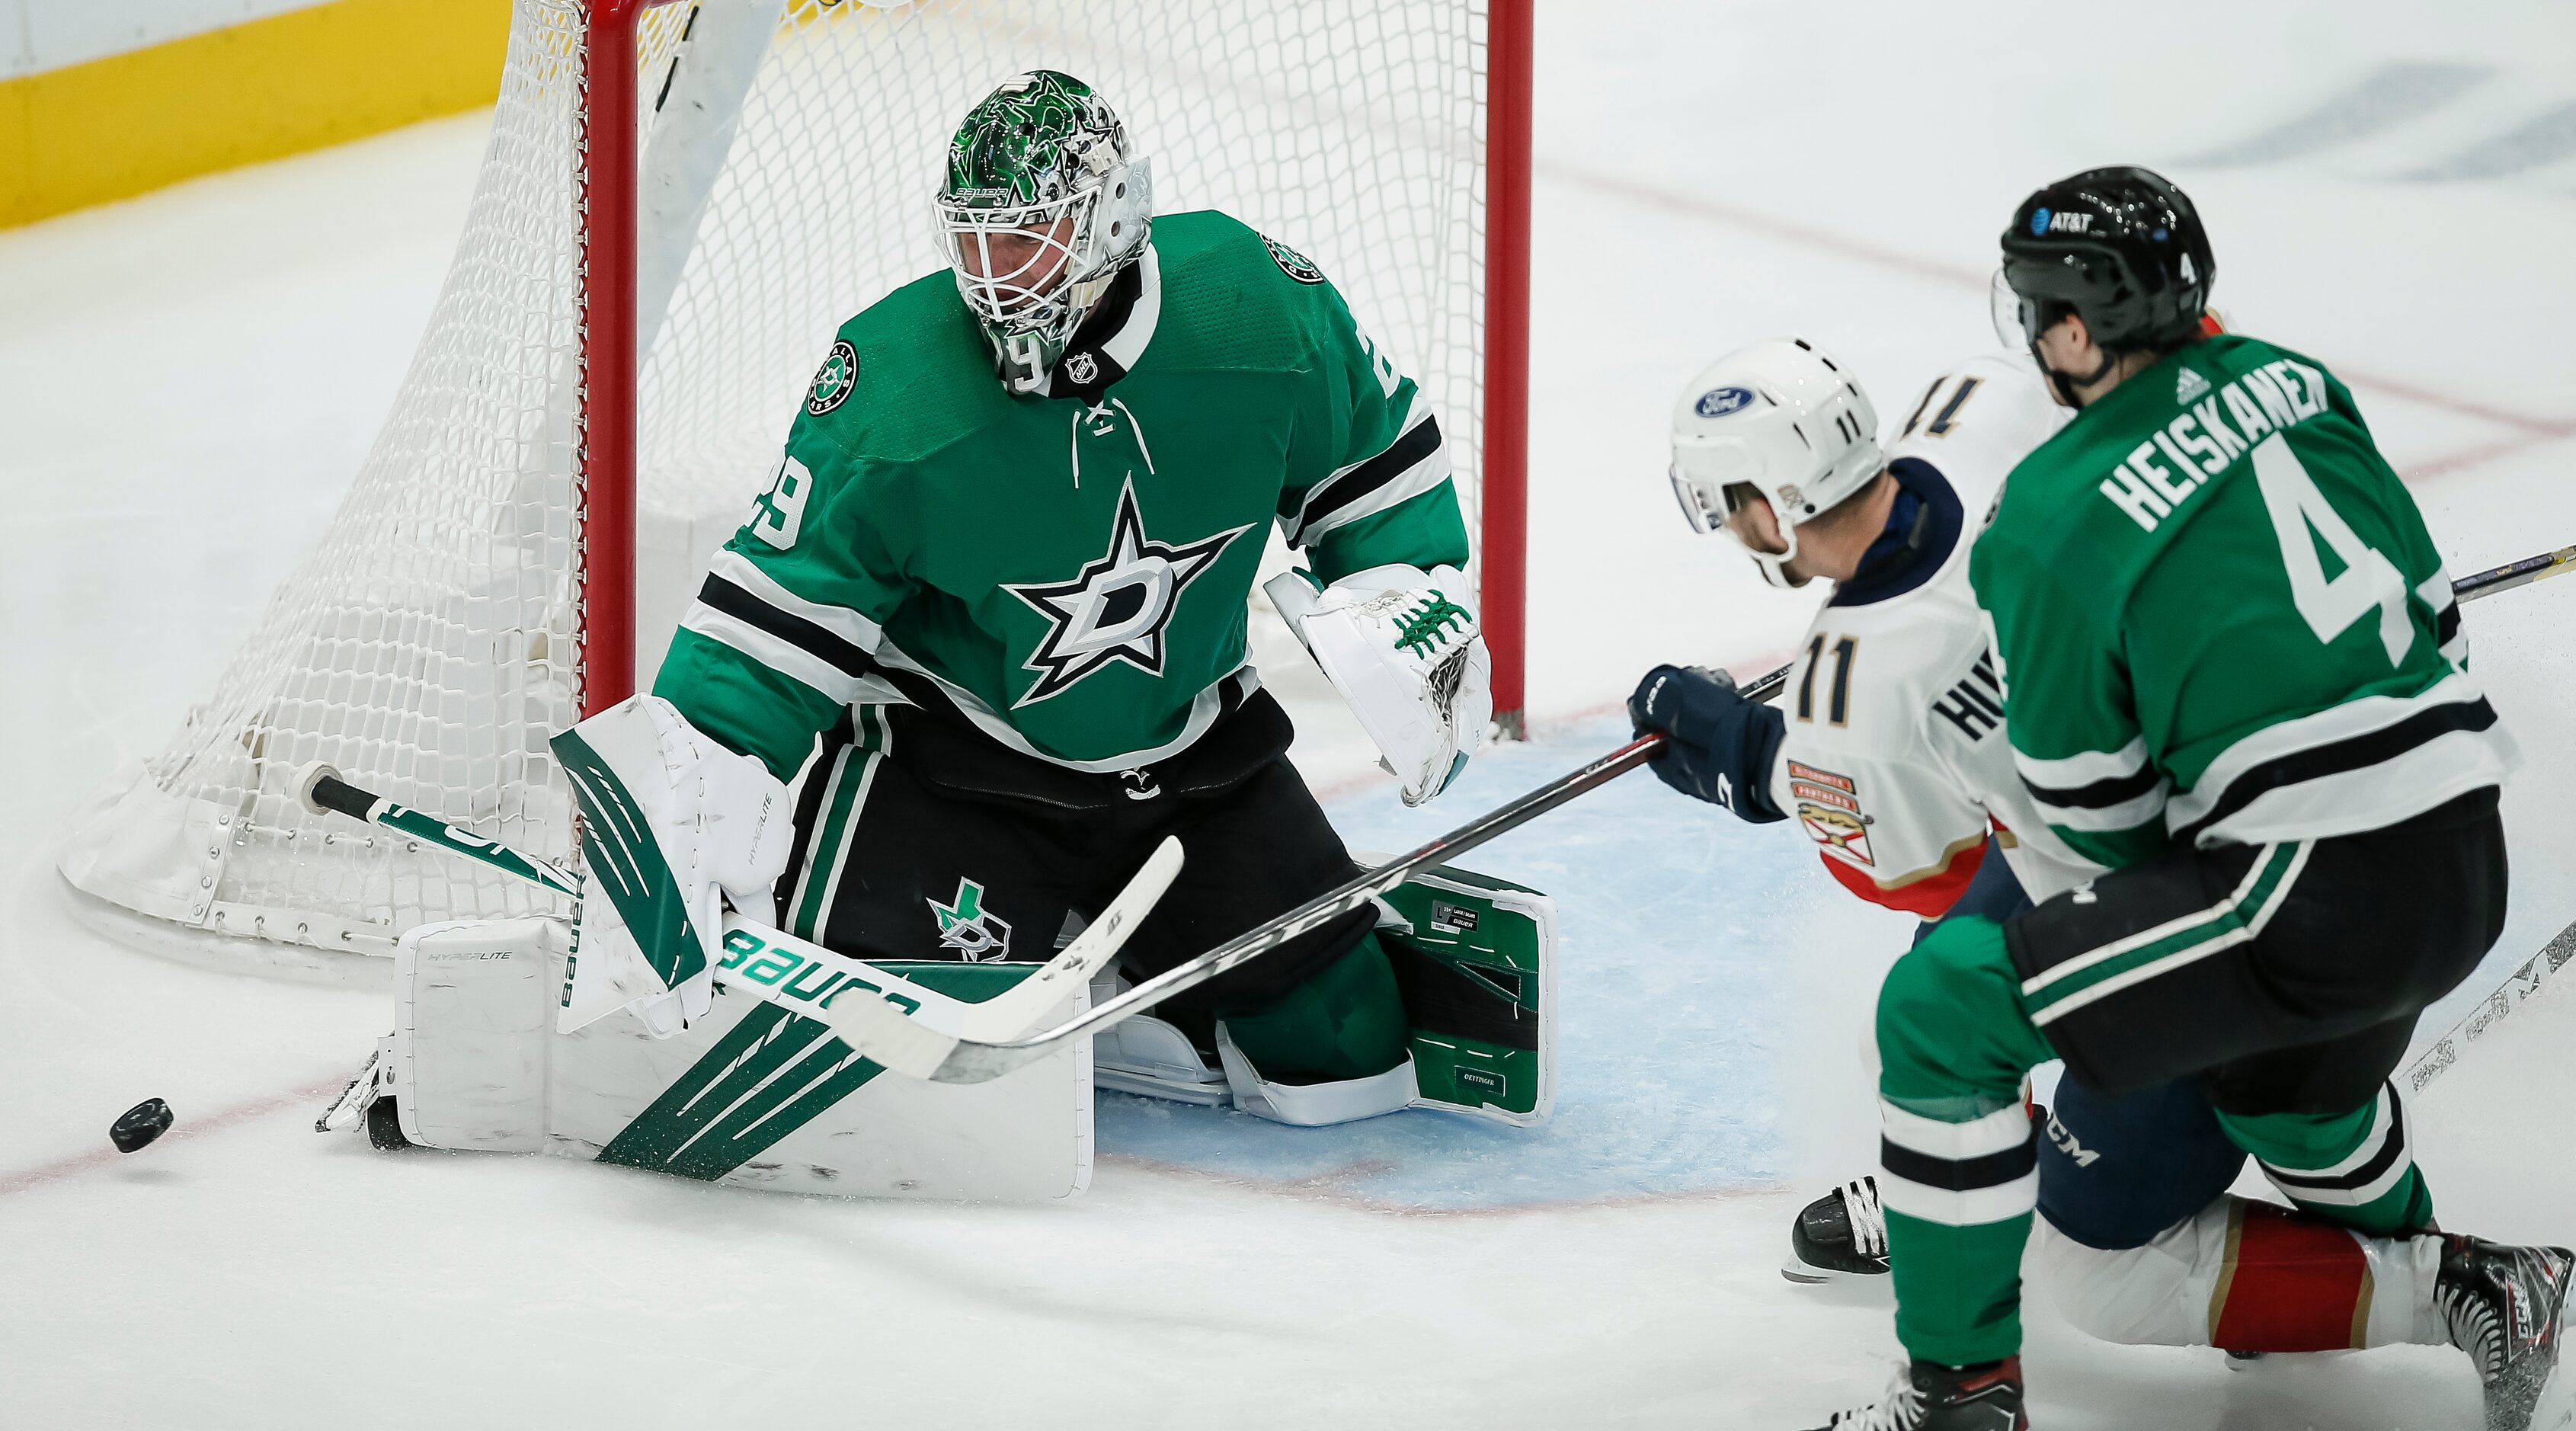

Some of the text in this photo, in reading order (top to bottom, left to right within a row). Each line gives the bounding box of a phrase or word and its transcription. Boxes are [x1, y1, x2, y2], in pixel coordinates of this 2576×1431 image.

[2050, 212, 2094, 232] AT&T
[2180, 252, 2197, 285] 4
[831, 347, 853, 387] ALLAS
[1075, 360, 1090, 379] NHL
[1701, 389, 1742, 415] Ford
[1836, 409, 1861, 445] 11
[2099, 358, 2328, 533] HEISKANEN
[2251, 429, 2415, 670] 4
[1796, 632, 1859, 729] 11
[1931, 646, 2006, 741] HU
[748, 792, 773, 865] HYPERLITE
[1436, 907, 1443, 919] L
[427, 952, 512, 961] HYPERLITE
[561, 875, 587, 1007] BAUER
[1464, 1074, 1494, 1086] OETTINGER
[2047, 1111, 2101, 1167] CM
